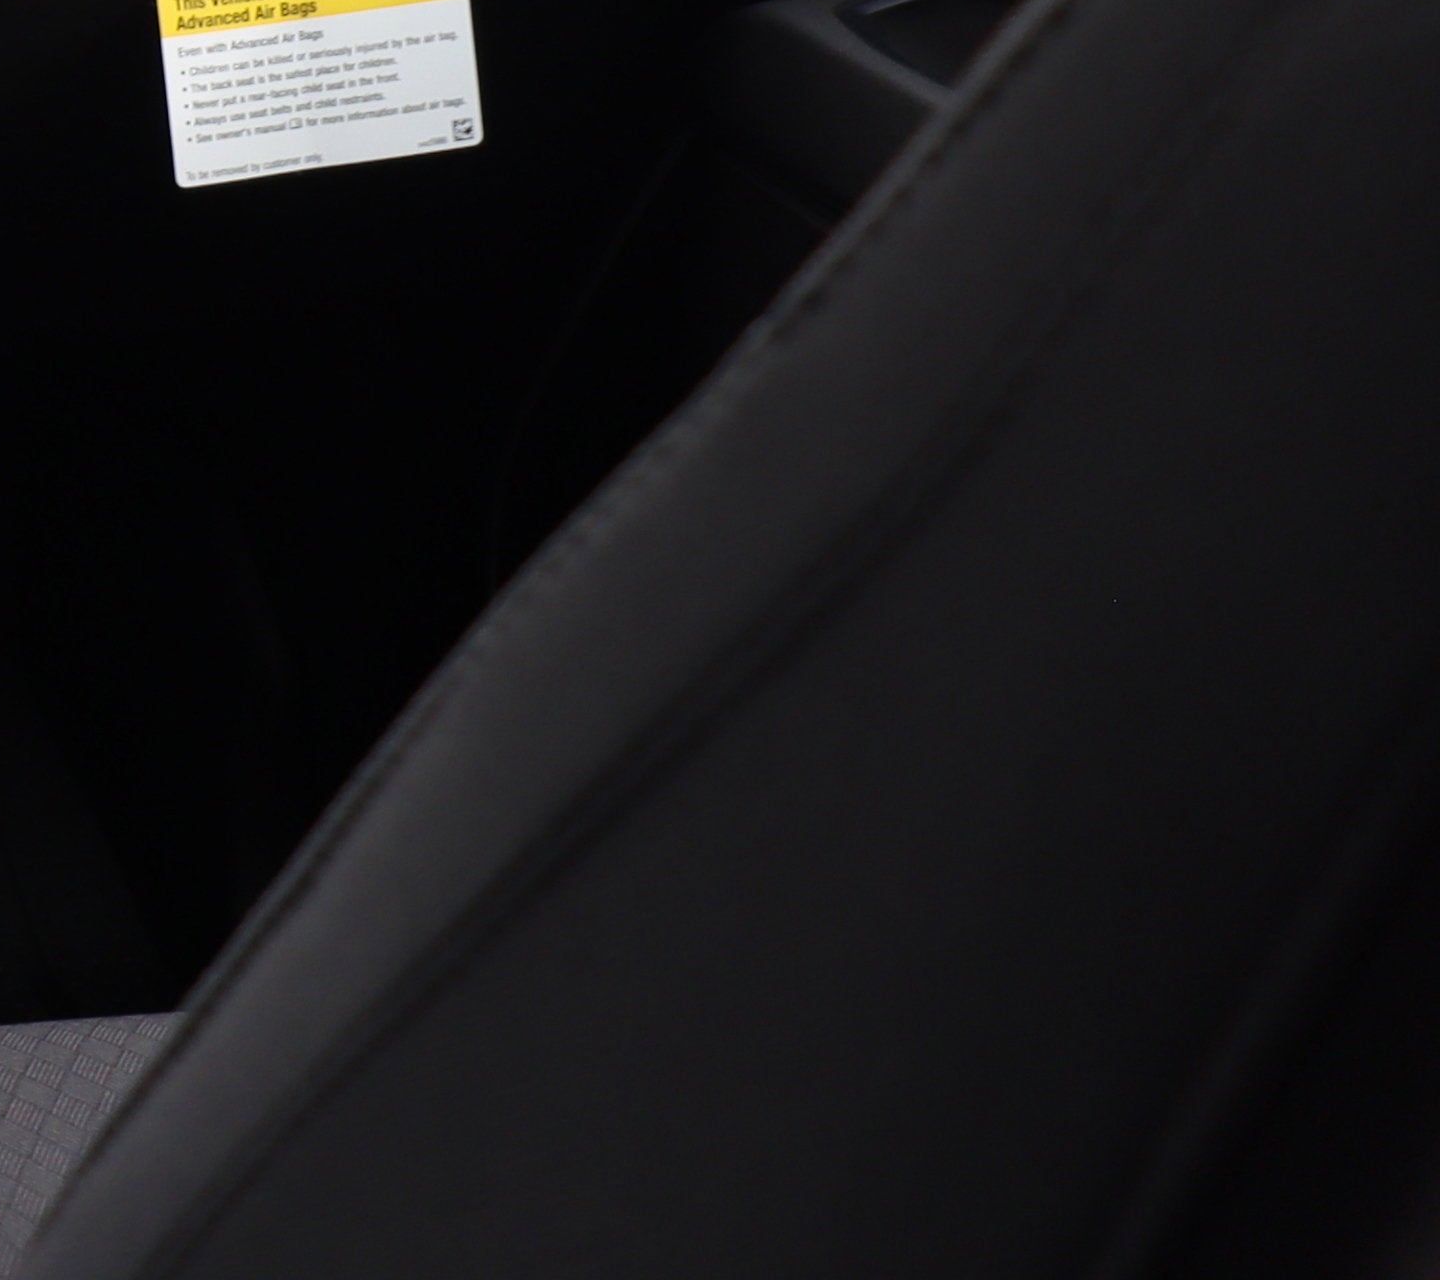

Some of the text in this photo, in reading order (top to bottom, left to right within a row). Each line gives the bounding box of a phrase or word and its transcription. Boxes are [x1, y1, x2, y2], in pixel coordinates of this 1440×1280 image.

[176, 3, 317, 30] Advanced Air Bags
[178, 29, 323, 58] Even with Advanced Air Bags
[189, 30, 457, 76] Children can be killed or seriously injured by the air bag.
[191, 57, 396, 93] The back seat is the safest place for children.
[193, 70, 400, 110] Never put a rear-facing child seat in the front.
[194, 91, 385, 127] Always use seat belts and child restraints.
[196, 98, 466, 143] See owner's manual for more information about air bags.
